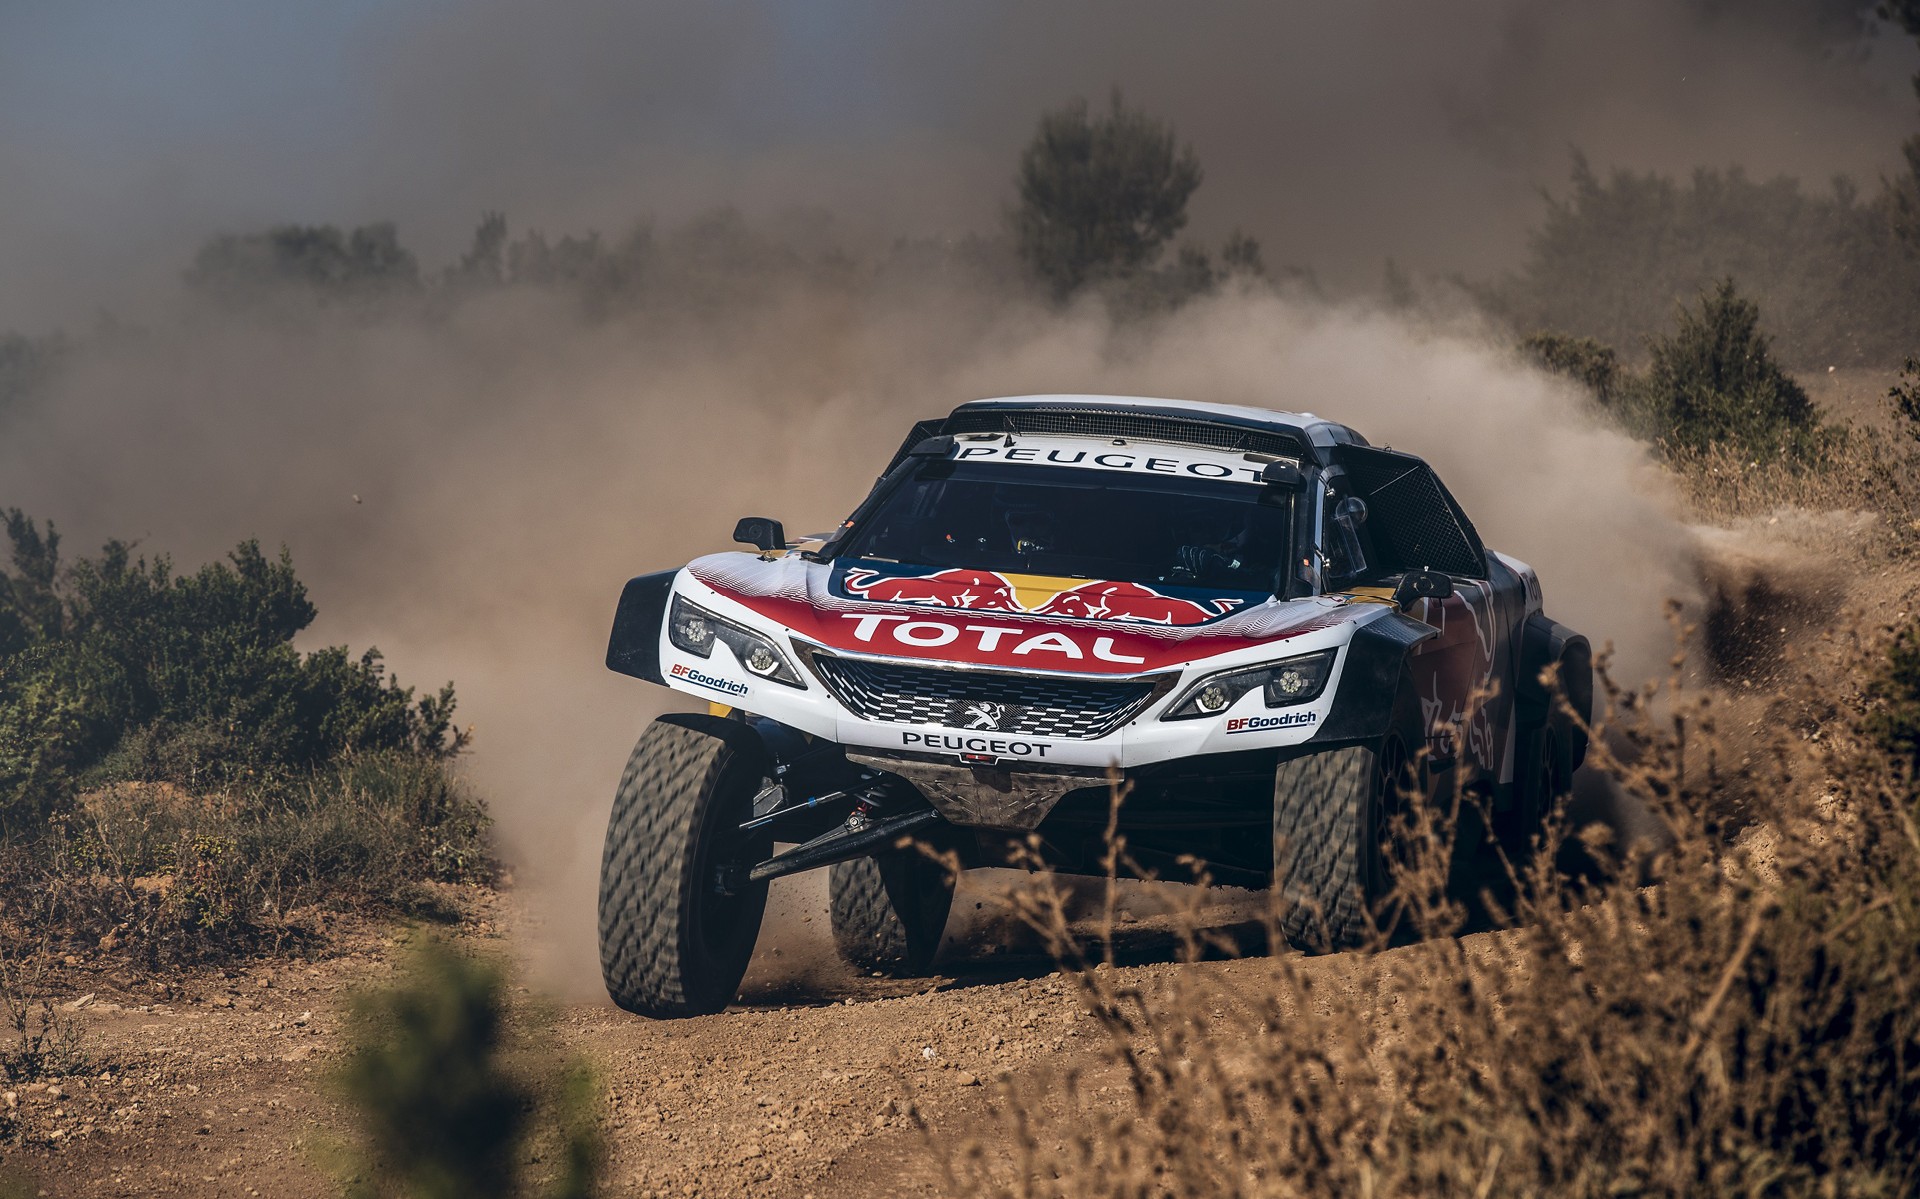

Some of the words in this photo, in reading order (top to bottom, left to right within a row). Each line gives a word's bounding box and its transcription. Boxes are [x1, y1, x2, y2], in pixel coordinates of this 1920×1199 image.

[958, 447, 1263, 482] PEUGEOT
[841, 613, 1145, 665] TOTAL
[671, 663, 749, 695] BFGoodrich
[1226, 711, 1317, 731] BFGoodrich
[902, 731, 1052, 757] PEUGEOT
